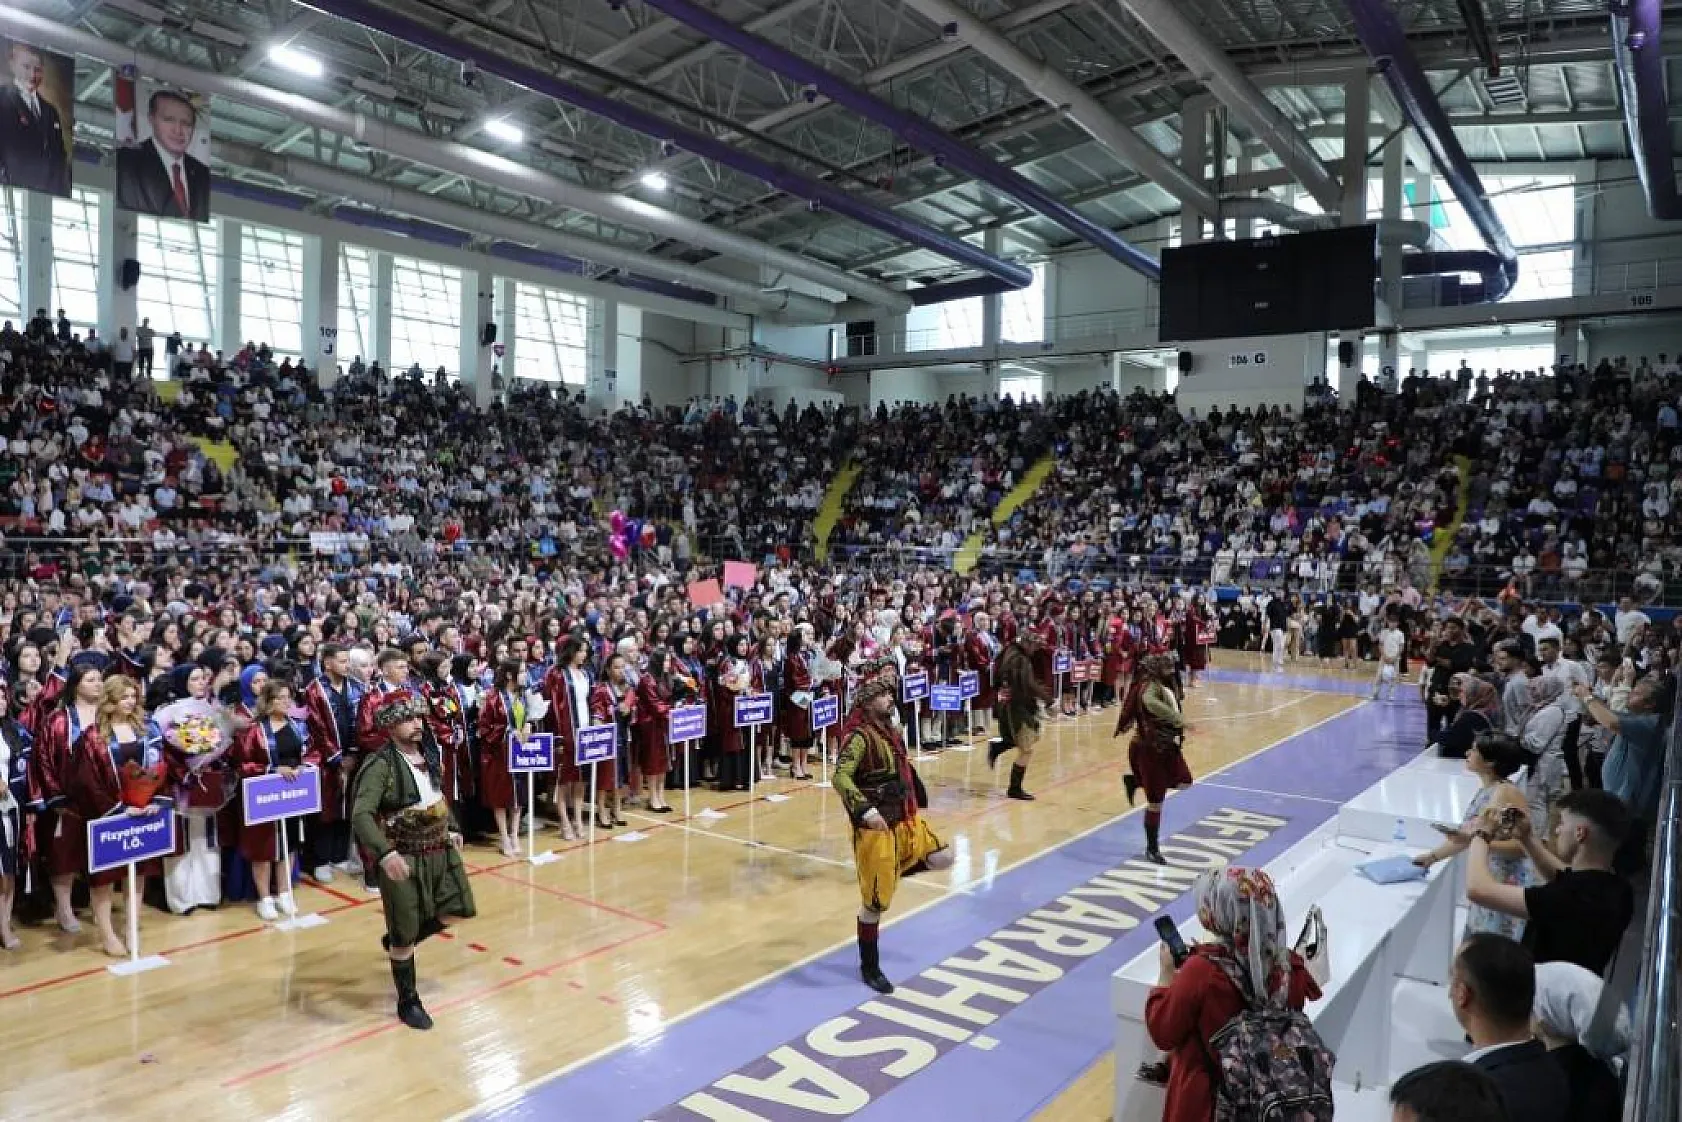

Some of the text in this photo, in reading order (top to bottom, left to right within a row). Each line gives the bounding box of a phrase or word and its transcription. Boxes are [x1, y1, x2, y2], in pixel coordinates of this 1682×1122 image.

[323, 342, 333, 355] J
[1254, 352, 1266, 364] G
[100, 817, 165, 844] Fizyoterapi
[642, 807, 1288, 1122] AFYONKARAHİSA
